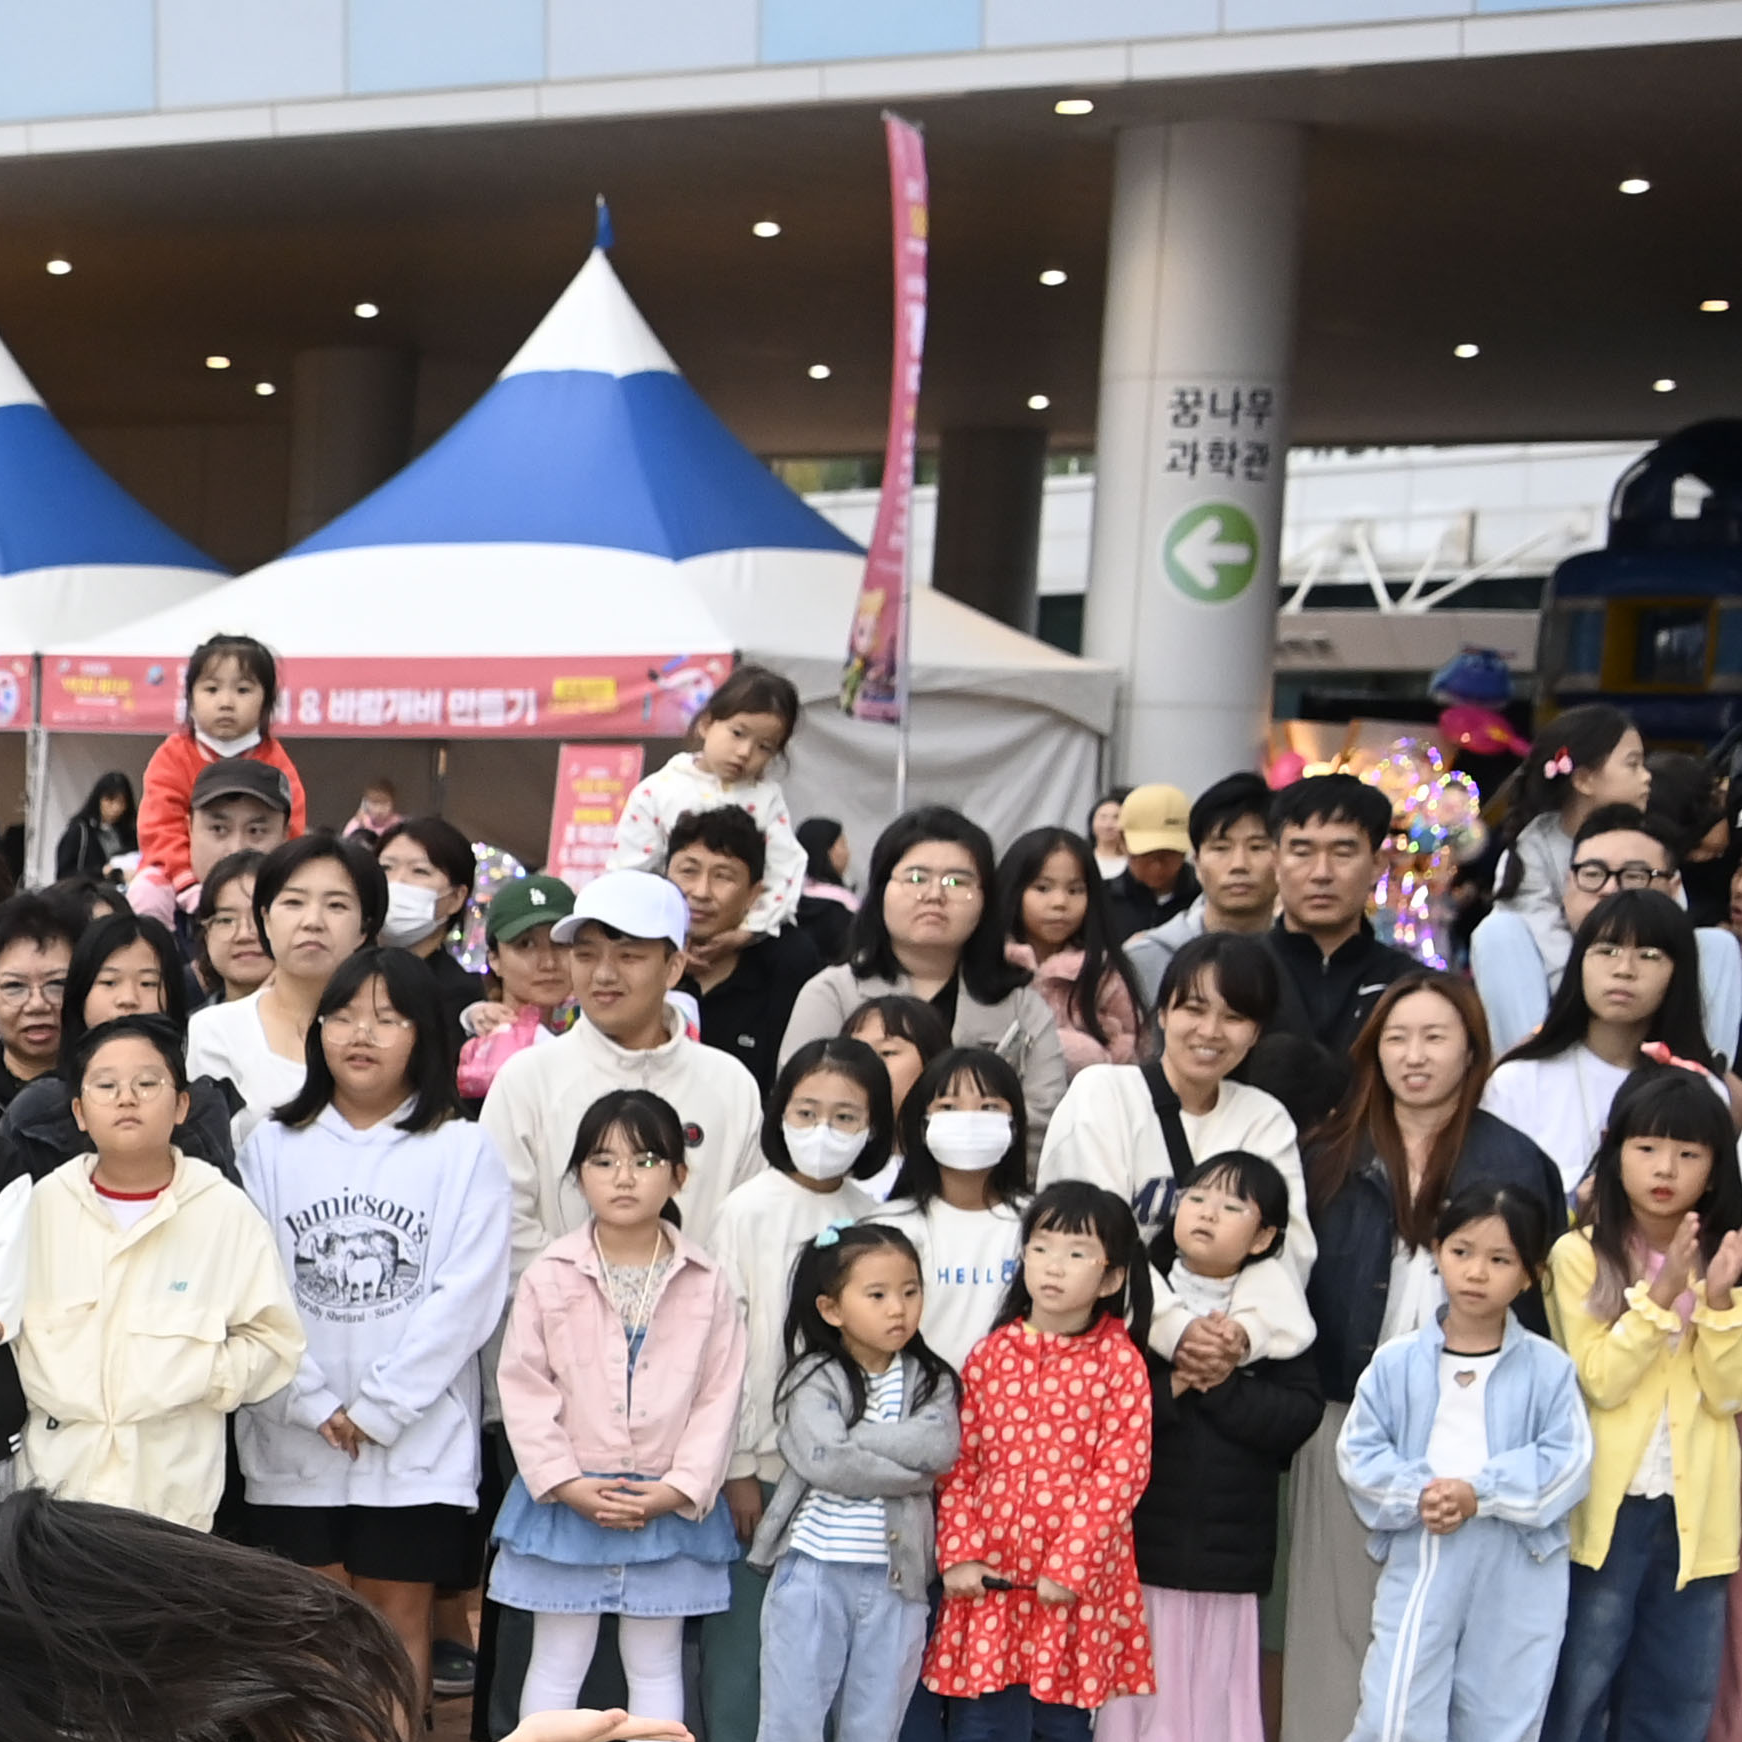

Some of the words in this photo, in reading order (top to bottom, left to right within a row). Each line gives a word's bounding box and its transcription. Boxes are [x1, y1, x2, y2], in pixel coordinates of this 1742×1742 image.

[1165, 438, 1270, 482] 과학관
[327, 690, 442, 727] 바람개비
[447, 689, 538, 727] 만들기
[284, 1186, 429, 1248] Jamieson's
